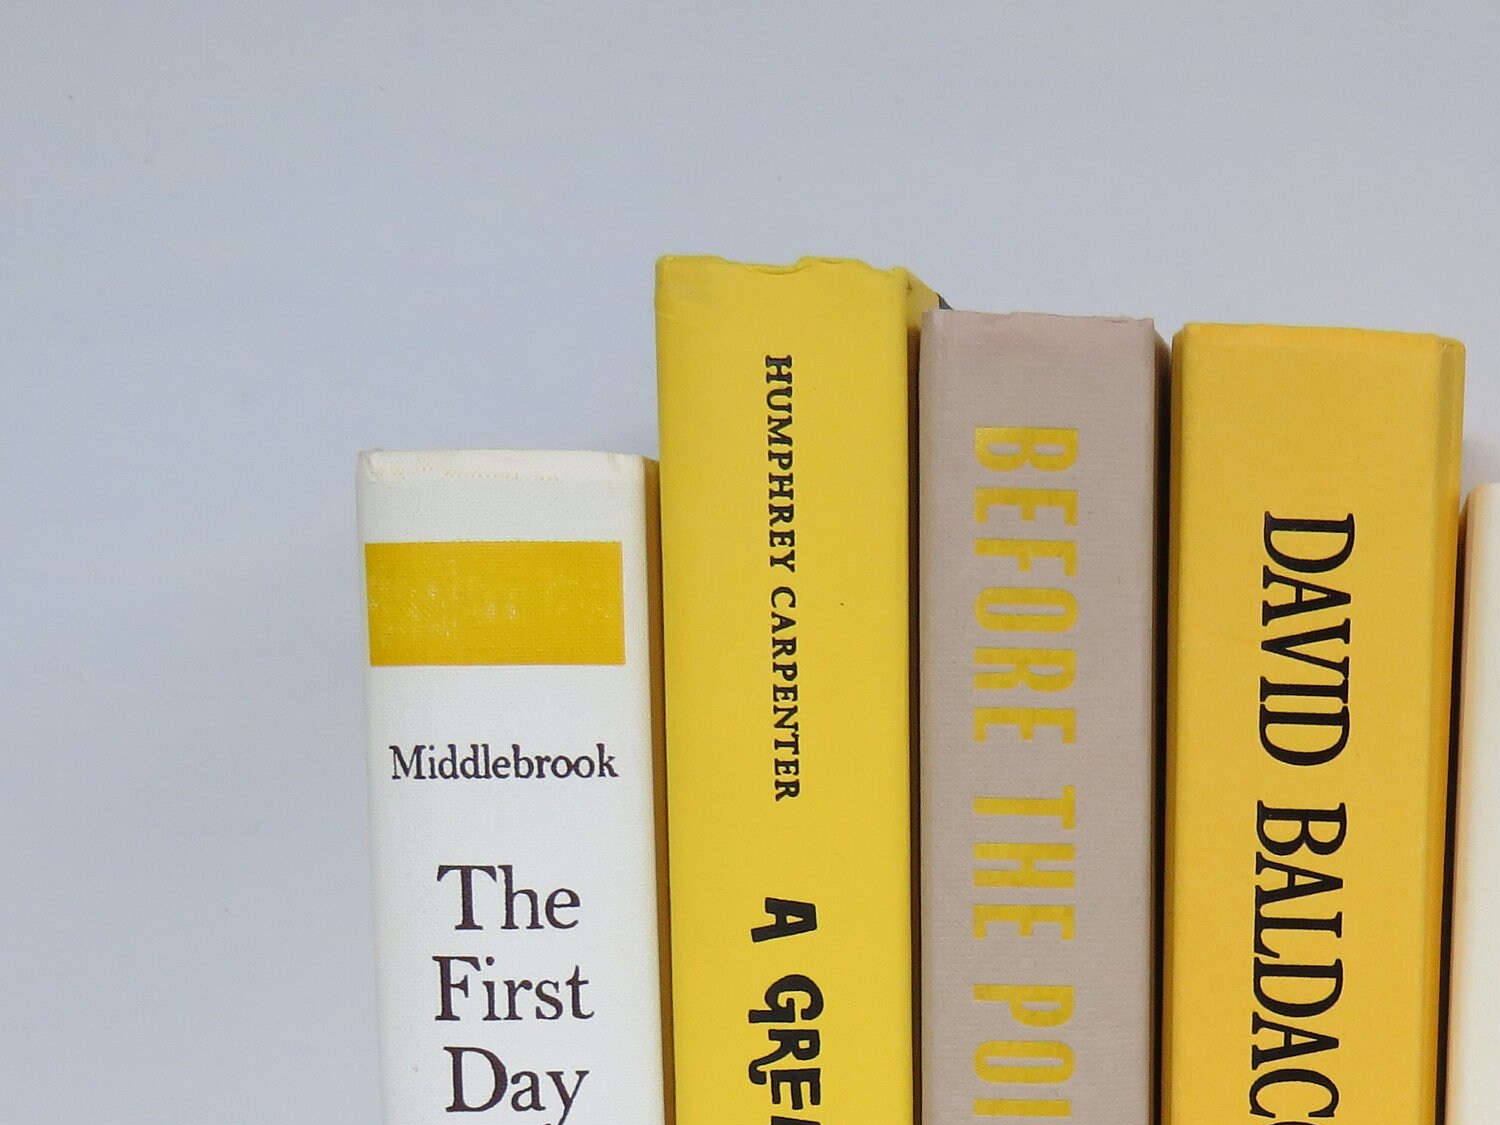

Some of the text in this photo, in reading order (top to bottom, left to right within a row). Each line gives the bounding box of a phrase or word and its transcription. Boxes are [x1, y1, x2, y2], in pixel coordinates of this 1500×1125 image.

[765, 354, 801, 802] HUMPHREY CARPENTER
[973, 427, 1079, 745] BEFORE
[1258, 511, 1356, 767] DAVID
[388, 742, 619, 780] Middlebrook
[436, 864, 581, 931] The
[972, 785, 1076, 941] THE
[750, 896, 818, 943] A
[431, 955, 595, 1022] First
